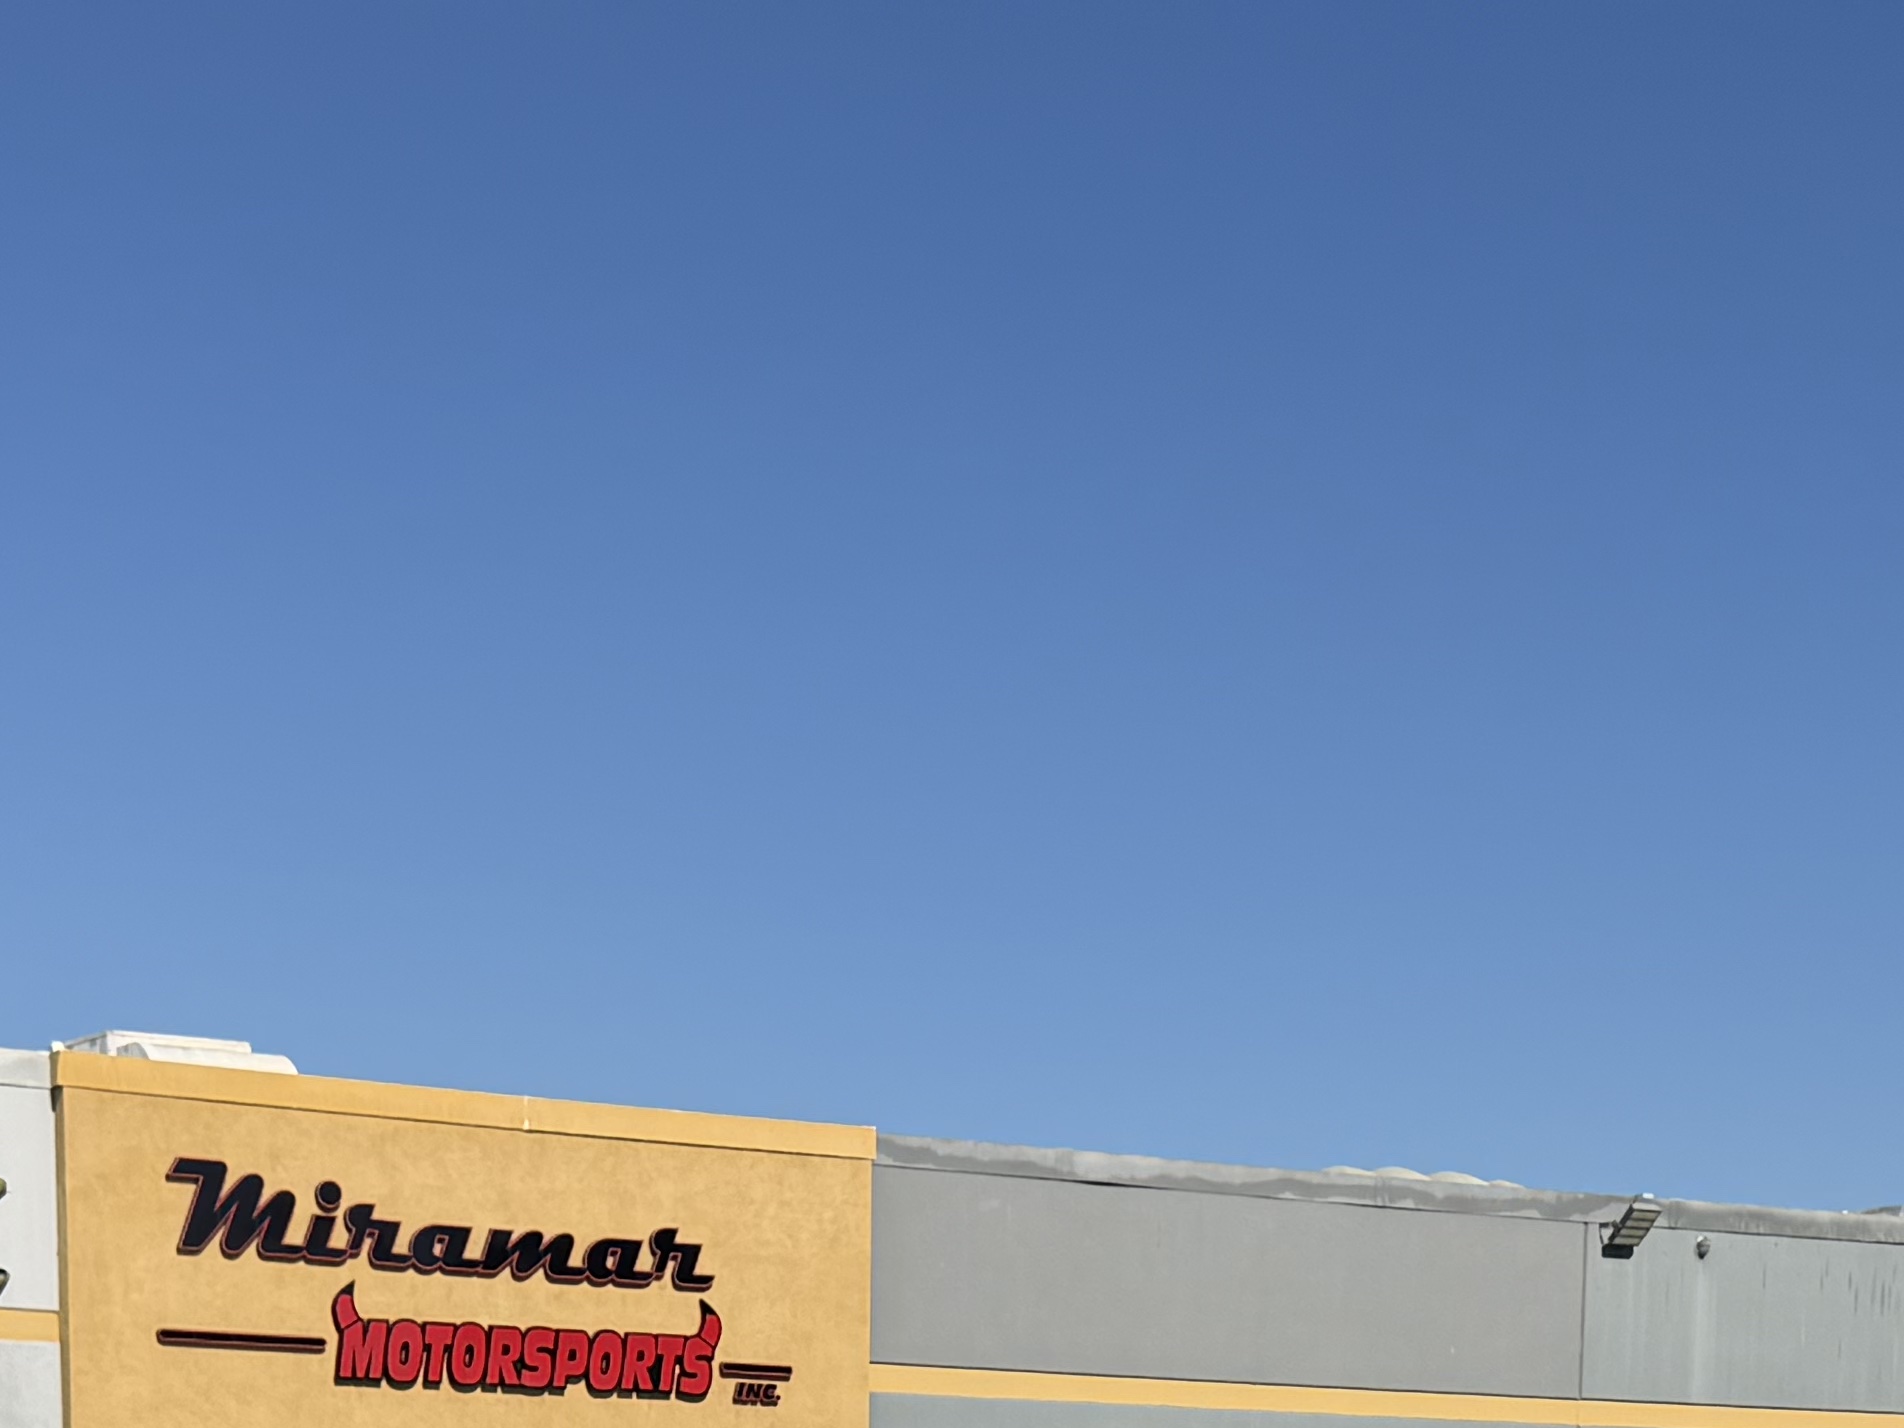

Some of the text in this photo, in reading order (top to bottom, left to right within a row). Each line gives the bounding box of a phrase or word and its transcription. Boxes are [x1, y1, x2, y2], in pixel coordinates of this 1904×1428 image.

[165, 1156, 716, 1292] Miramar
[334, 1310, 718, 1402] MOTORSPORTS
[732, 1382, 781, 1406] INC.
